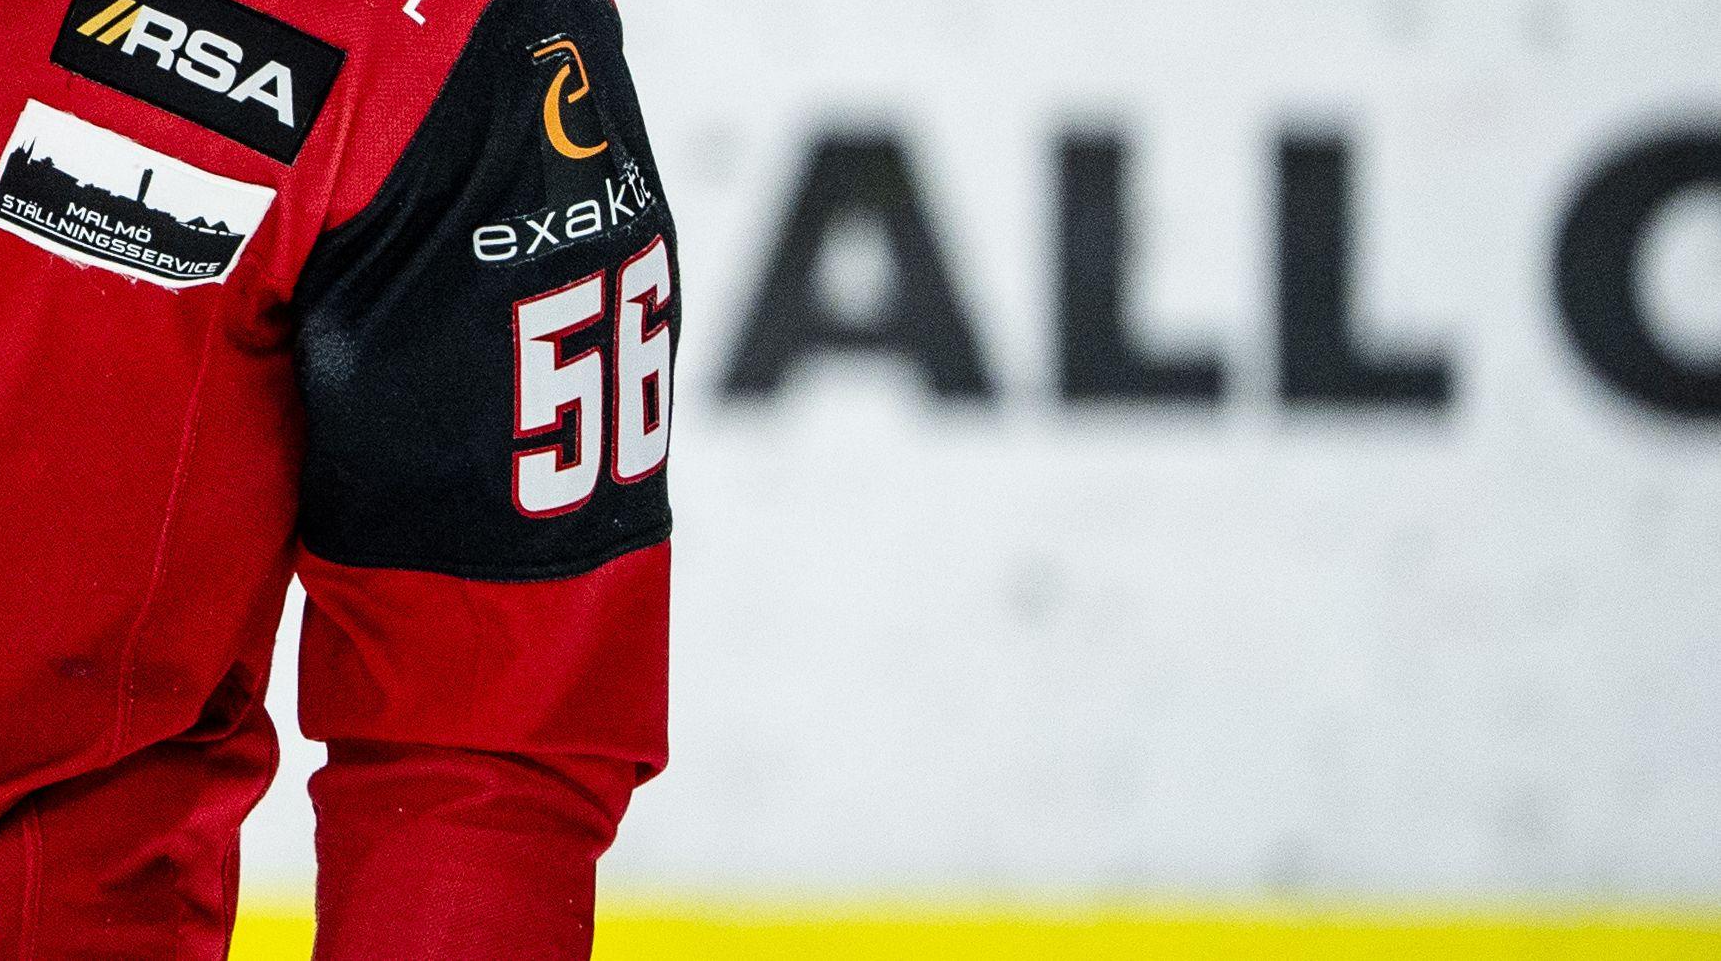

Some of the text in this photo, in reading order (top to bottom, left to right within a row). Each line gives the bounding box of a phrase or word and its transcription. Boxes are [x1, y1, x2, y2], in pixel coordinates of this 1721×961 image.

[121, 4, 295, 129] RSA
[1, 193, 222, 274] STÄLLNINGSSERVICE
[65, 201, 152, 244] MALMÖ
[511, 234, 672, 520] 56
